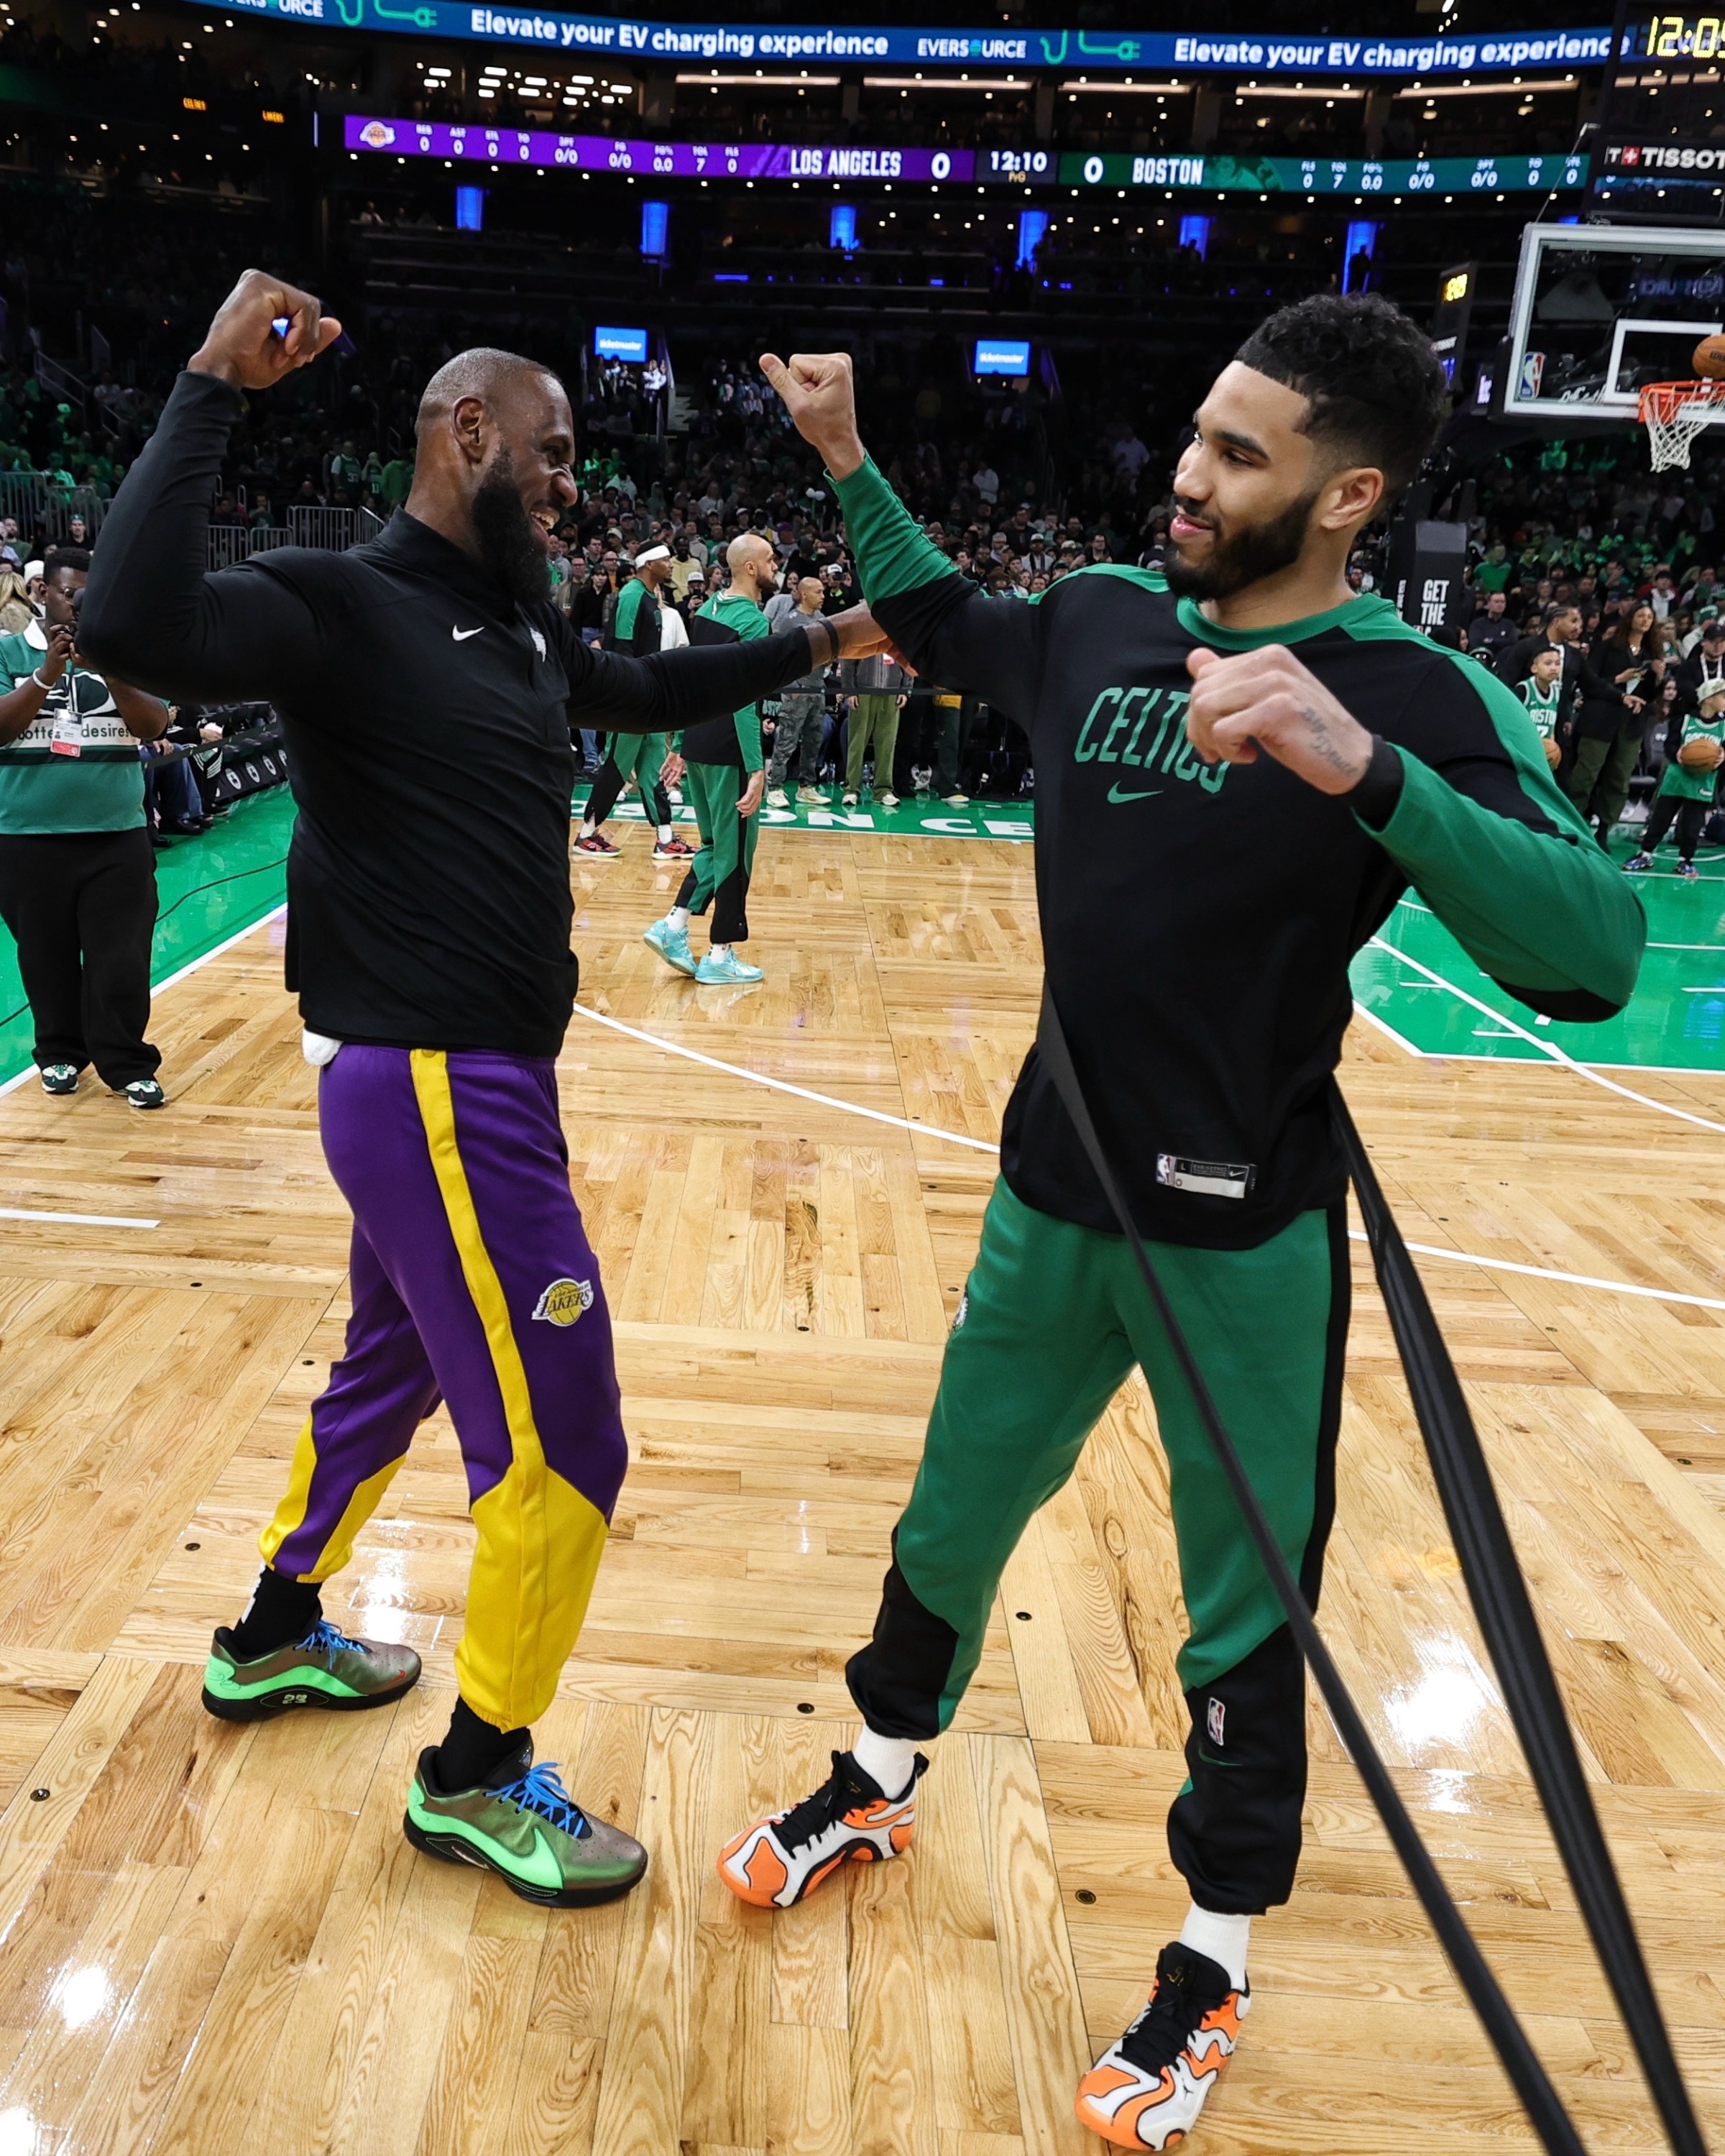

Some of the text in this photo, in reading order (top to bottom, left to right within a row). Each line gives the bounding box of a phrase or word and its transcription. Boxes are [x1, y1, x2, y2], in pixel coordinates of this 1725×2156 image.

[471, 9, 888, 58] Elevate your EV charging experience
[917, 38, 1026, 58] EVERSOURCE
[1174, 38, 1264, 63] Elevate
[1266, 45, 1324, 69] your
[1328, 42, 1361, 66] EV
[1363, 41, 1476, 71] charging
[420, 136, 737, 173] 0 0 0 0 0/0 0/0 0.0 7 0
[791, 149, 951, 180] LOS ANGELES 0
[990, 150, 1047, 173] 12:10
[1641, 146, 1725, 170] TISSOT
[1084, 156, 1204, 185] 0 BOSTON
[1302, 169, 1578, 191] 0 7 0.0 0/0 0/0 0 0
[1422, 579, 1450, 602] GET
[1421, 602, 1447, 625] THE
[81, 723, 129, 738] desires
[536, 1289, 590, 1317] LAKERS
